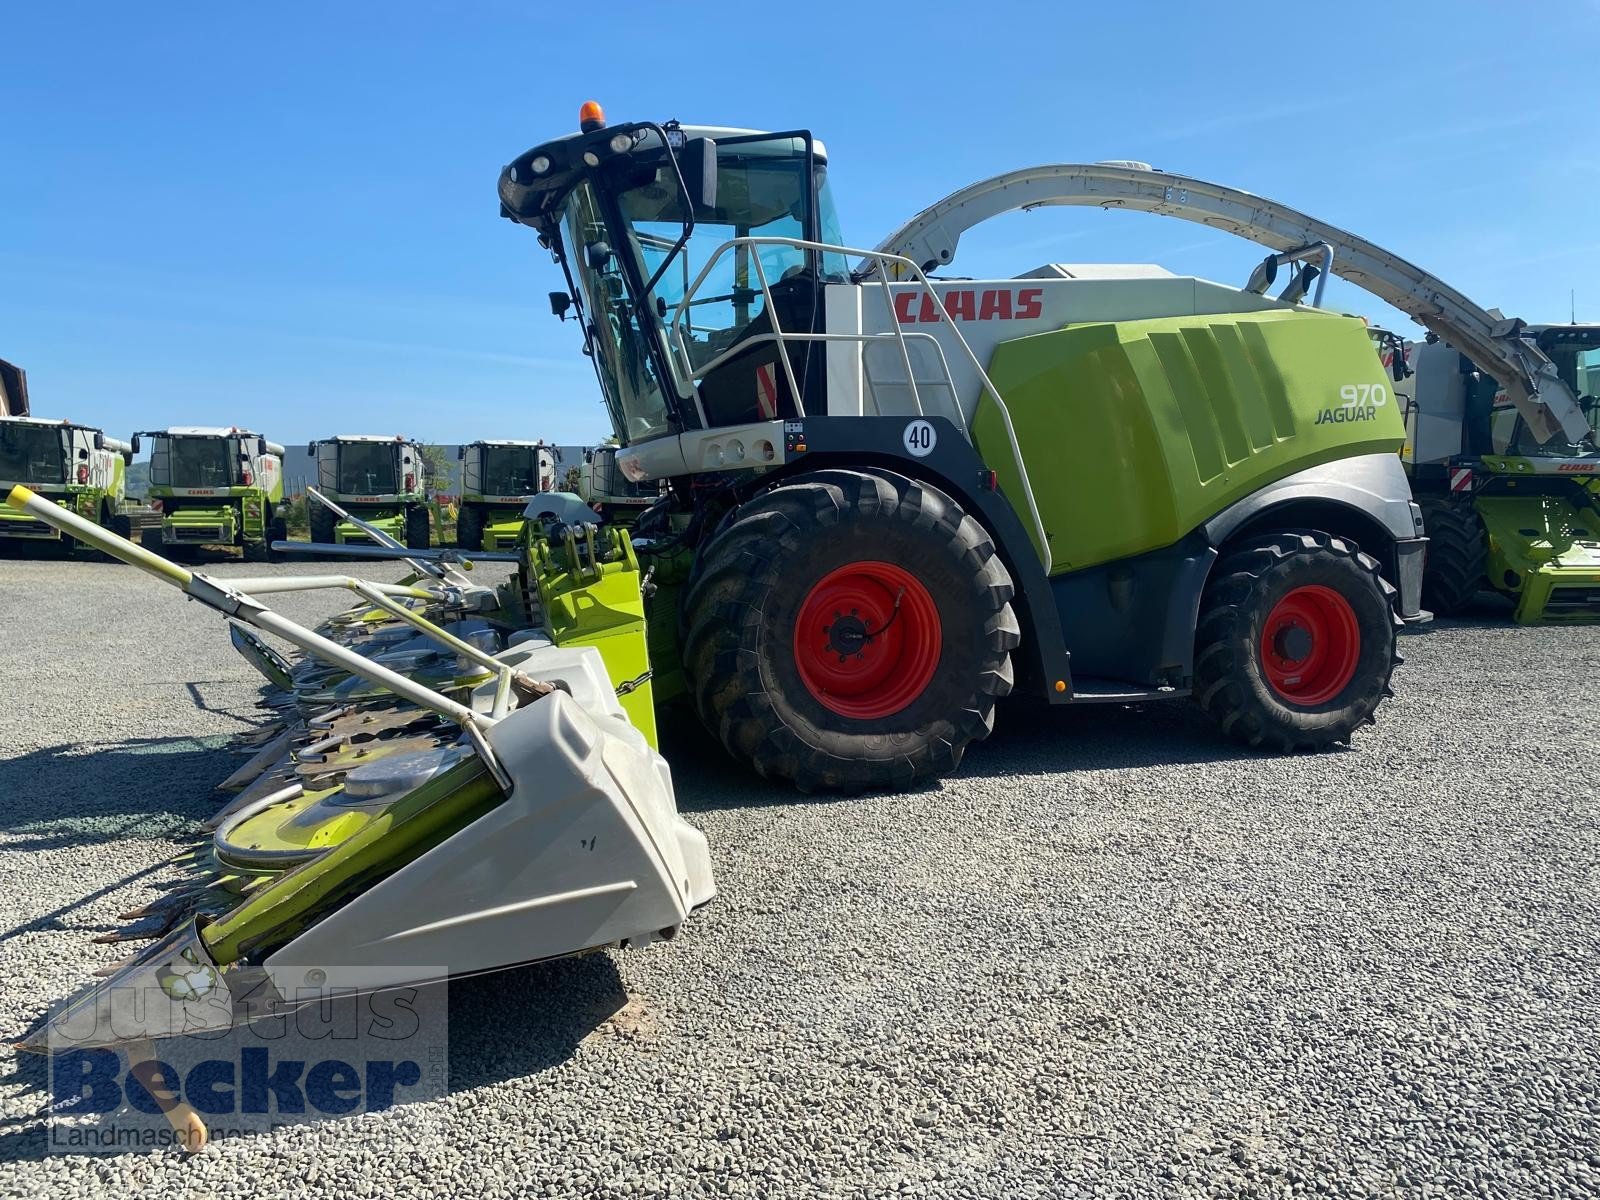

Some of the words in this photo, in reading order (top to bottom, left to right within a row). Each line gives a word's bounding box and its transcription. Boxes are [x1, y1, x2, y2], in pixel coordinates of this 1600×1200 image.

[895, 289, 1043, 323] CLAAS
[1340, 383, 1386, 408] 970
[1314, 405, 1376, 425] JAGUAR
[908, 426, 930, 449] 40
